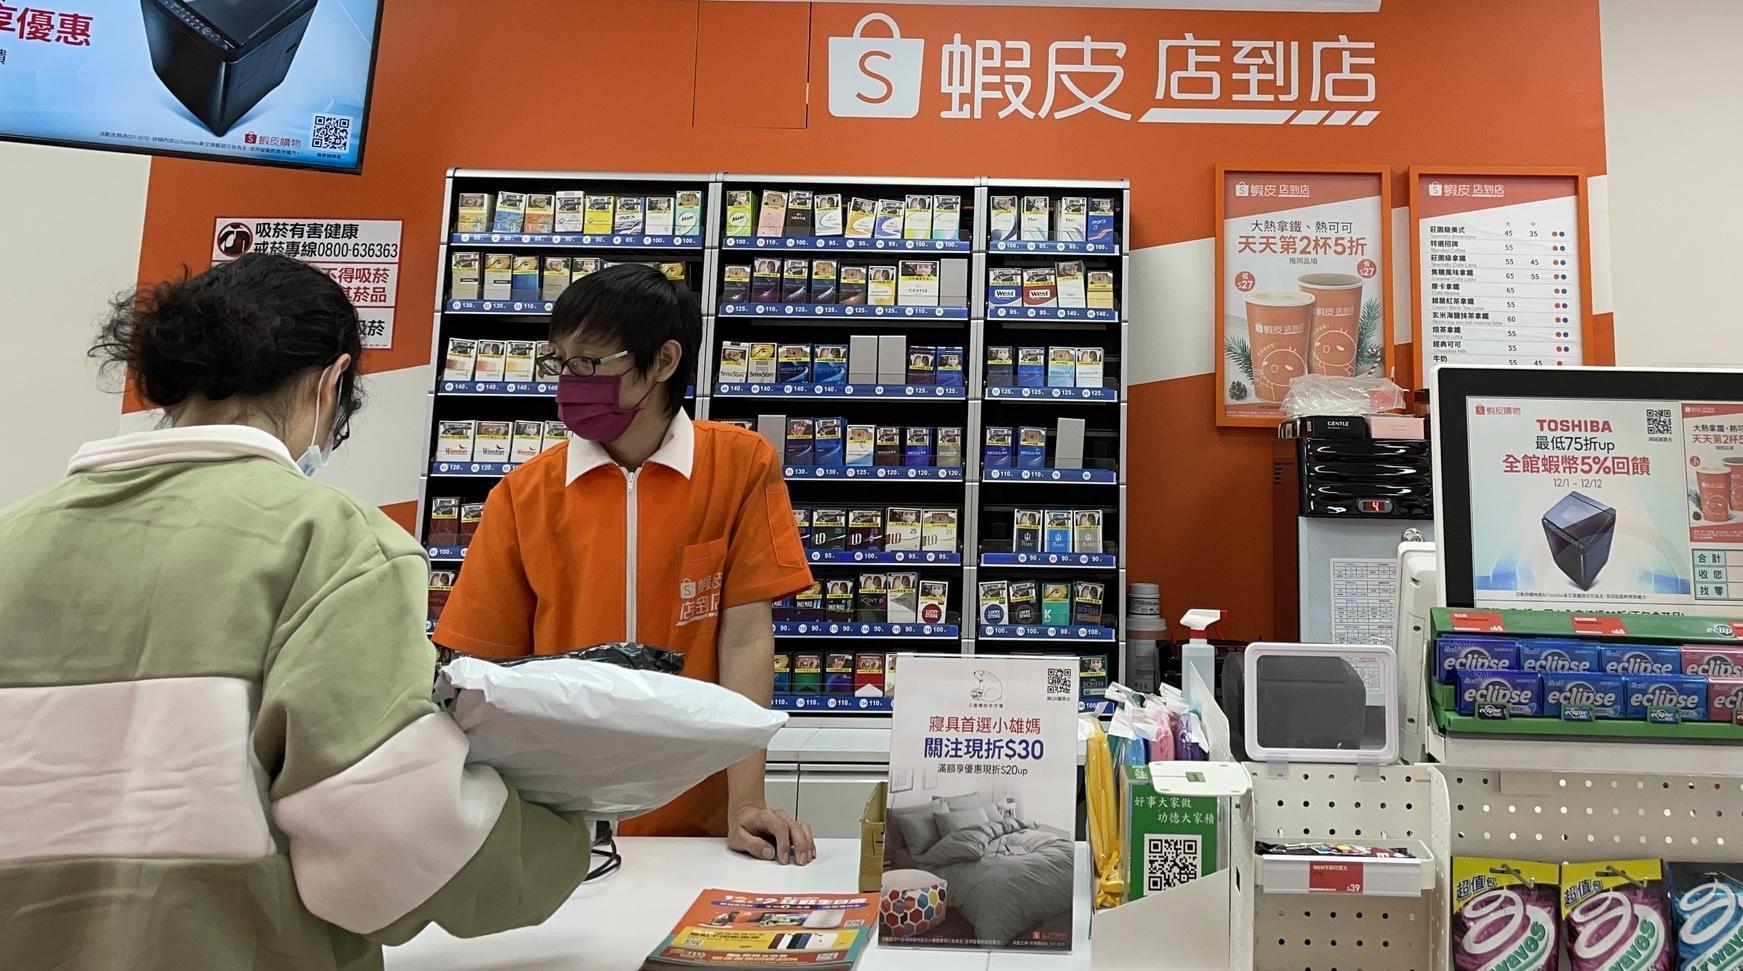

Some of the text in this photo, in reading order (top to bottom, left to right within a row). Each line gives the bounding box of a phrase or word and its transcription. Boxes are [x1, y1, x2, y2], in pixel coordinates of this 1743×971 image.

[940, 33, 1376, 121] 蝦皮 店到店
[1250, 184, 1310, 197] 蝦皮 店到店
[1443, 184, 1504, 196] 蝦皮 店到店
[255, 222, 359, 240] 吸菸有害健康
[1250, 219, 1353, 234] 大熱拿鐵、熱可可
[1237, 234, 1367, 256] 天天第2杯5折
[1359, 267, 1375, 277] $27
[1505, 272, 1515, 280] 65
[1237, 280, 1253, 289] $27
[995, 289, 1014, 297] West
[1030, 289, 1049, 297] West
[1433, 355, 1448, 363] 牛奶
[1536, 419, 1612, 433] TOSHIBA
[1535, 436, 1615, 454] 最低75折up
[1502, 453, 1650, 477] 全館蝦幣5%回饋
[1553, 478, 1570, 489] 12/1
[1581, 478, 1602, 489] 12/12
[1372, 501, 1379, 512] 4
[815, 532, 826, 545] LD
[851, 532, 862, 546] LD
[1706, 624, 1733, 637] eclip
[1444, 653, 1510, 671] eclipse
[1524, 655, 1590, 673] eclipse
[1606, 657, 1673, 675] eclipse
[1686, 659, 1743, 677] eclips
[1464, 684, 1532, 704] eclipse
[1548, 686, 1616, 706] eclipse
[1631, 687, 1699, 707] eclipse
[928, 715, 1041, 735] 寢具首選小雄媽
[924, 737, 1044, 761] 關注現折$30
[937, 763, 1028, 776] 滿額享優惠現折$20up
[1134, 795, 1191, 809] 好事大家做
[1157, 811, 1215, 824] 功德大家積
[1456, 875, 1497, 900] 超值包
[1563, 877, 1604, 906] 超值包
